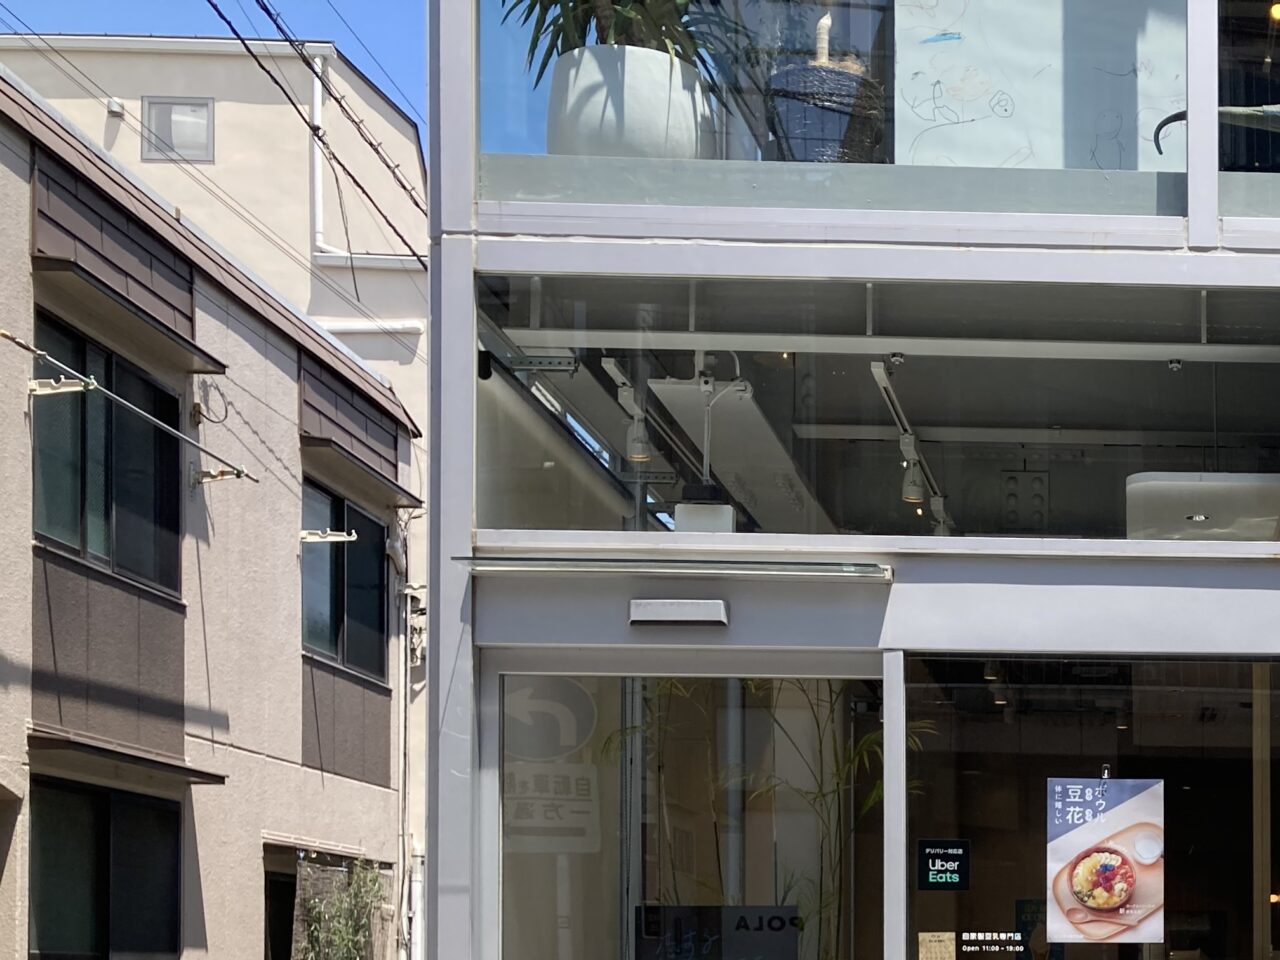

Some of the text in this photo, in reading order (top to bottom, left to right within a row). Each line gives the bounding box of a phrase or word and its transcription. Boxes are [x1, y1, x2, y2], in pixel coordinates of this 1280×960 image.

[1065, 784, 1084, 825] 豆花
[928, 859, 959, 871] Uber
[928, 871, 959, 883] Eats
